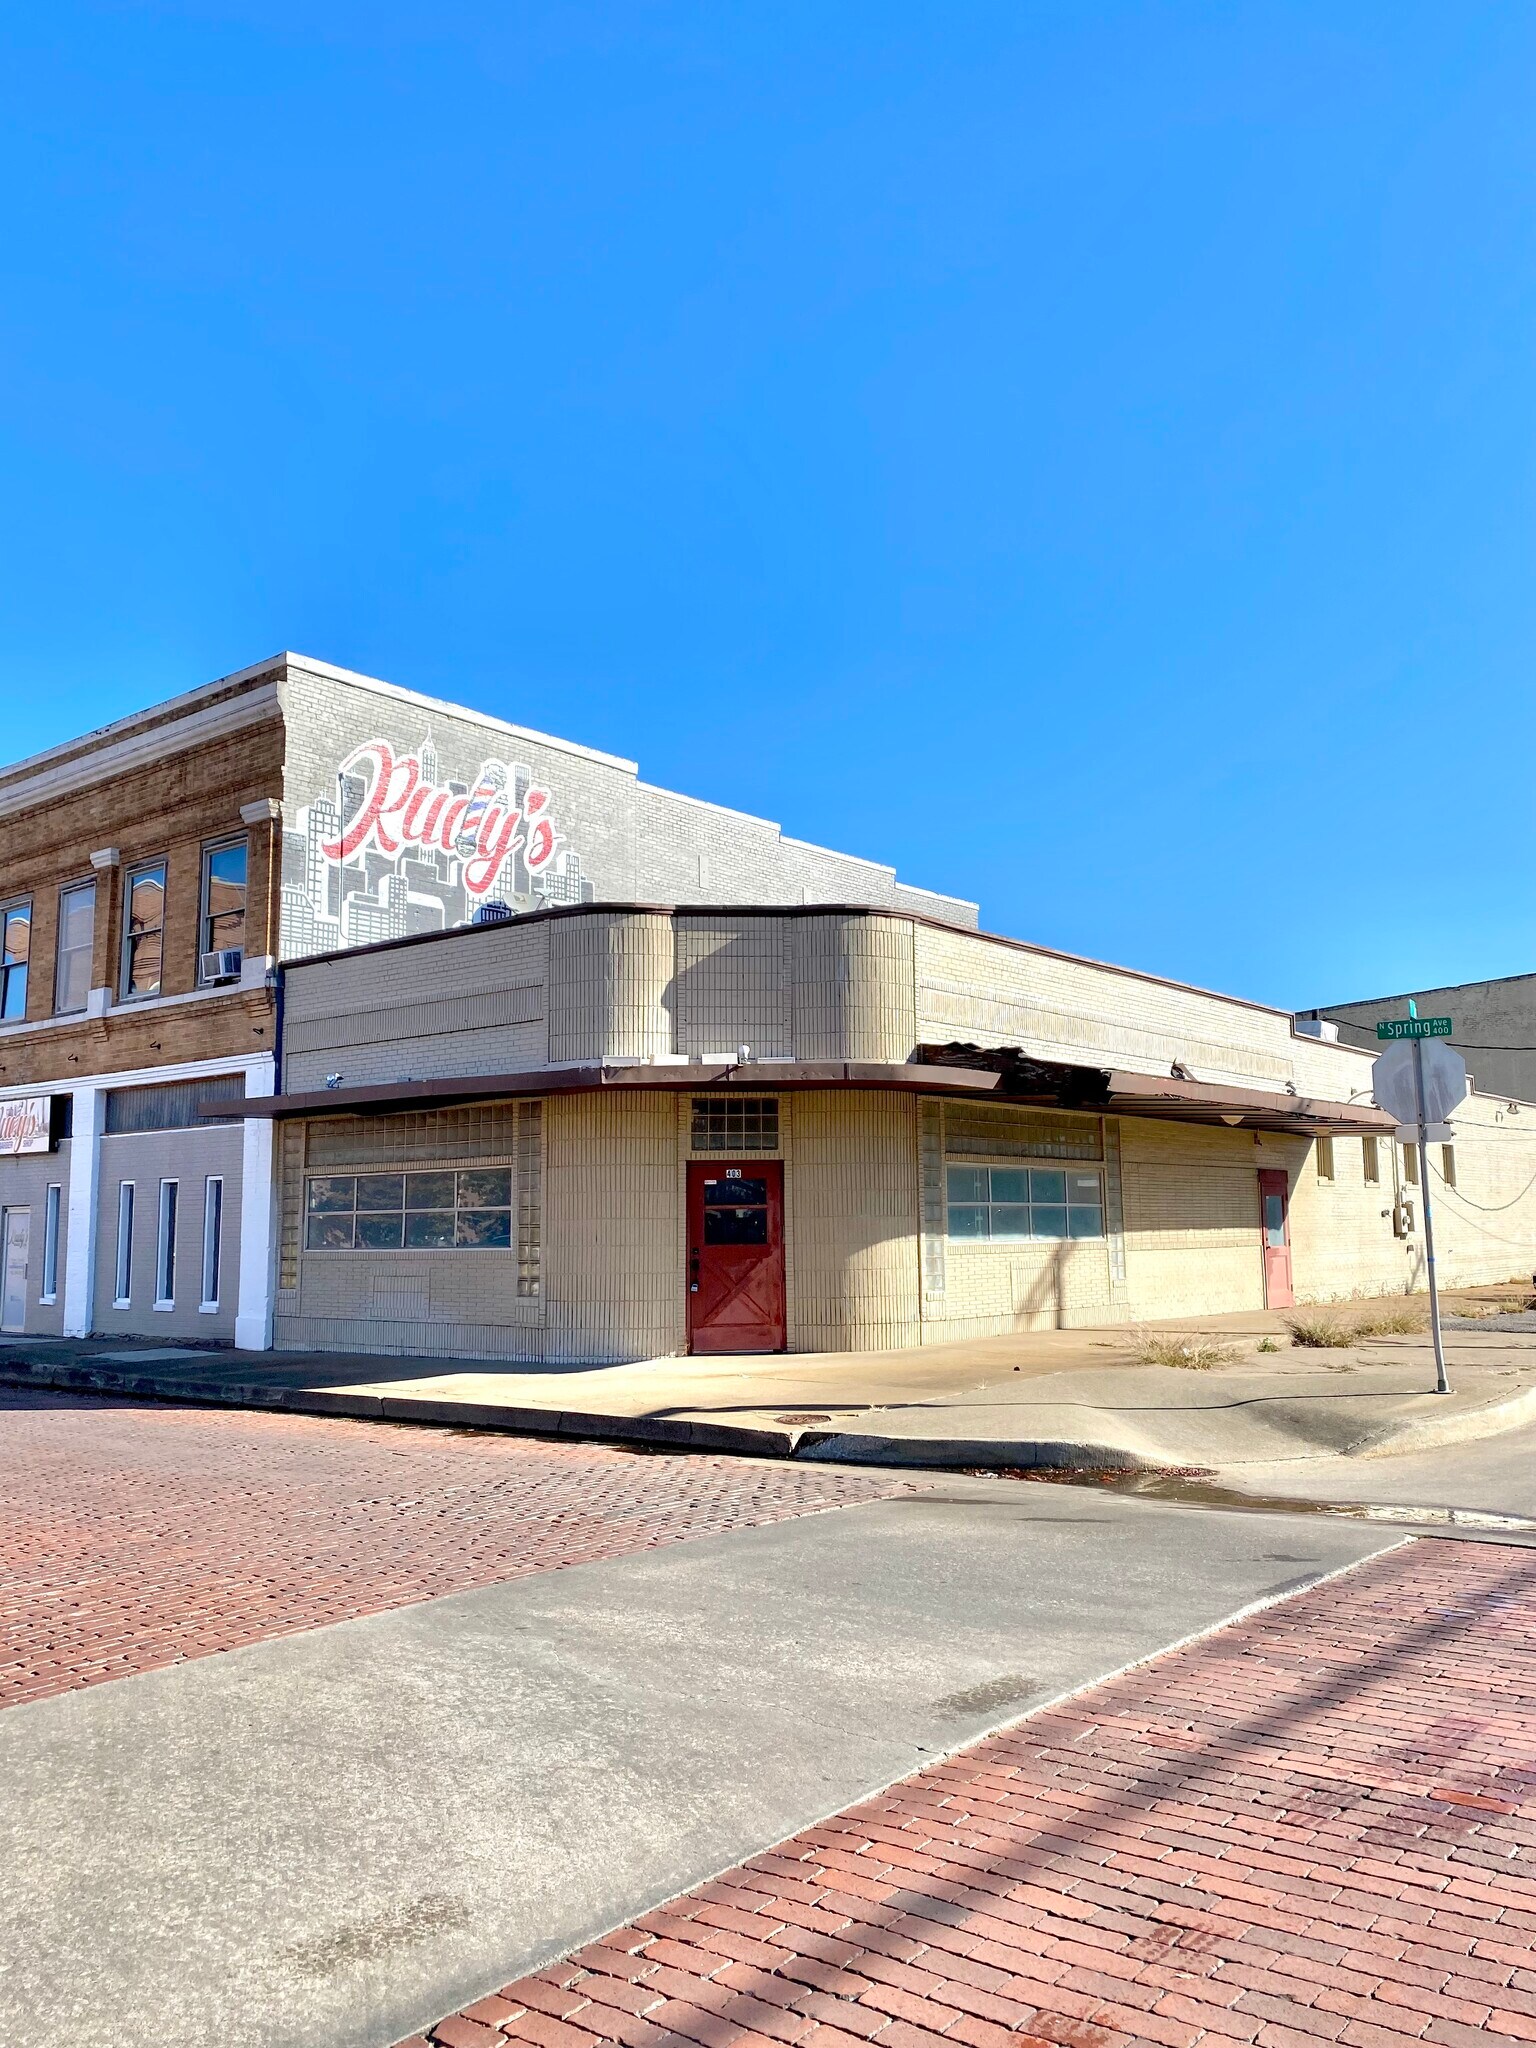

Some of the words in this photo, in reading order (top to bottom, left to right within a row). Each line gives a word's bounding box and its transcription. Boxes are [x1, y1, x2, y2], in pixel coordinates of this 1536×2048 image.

[321, 739, 562, 894] Rudy's
[1387, 1021, 1431, 1038] Spring
[1432, 1019, 1448, 1027] Ave
[1433, 1026, 1449, 1034] 400
[726, 1169, 742, 1178] 403
